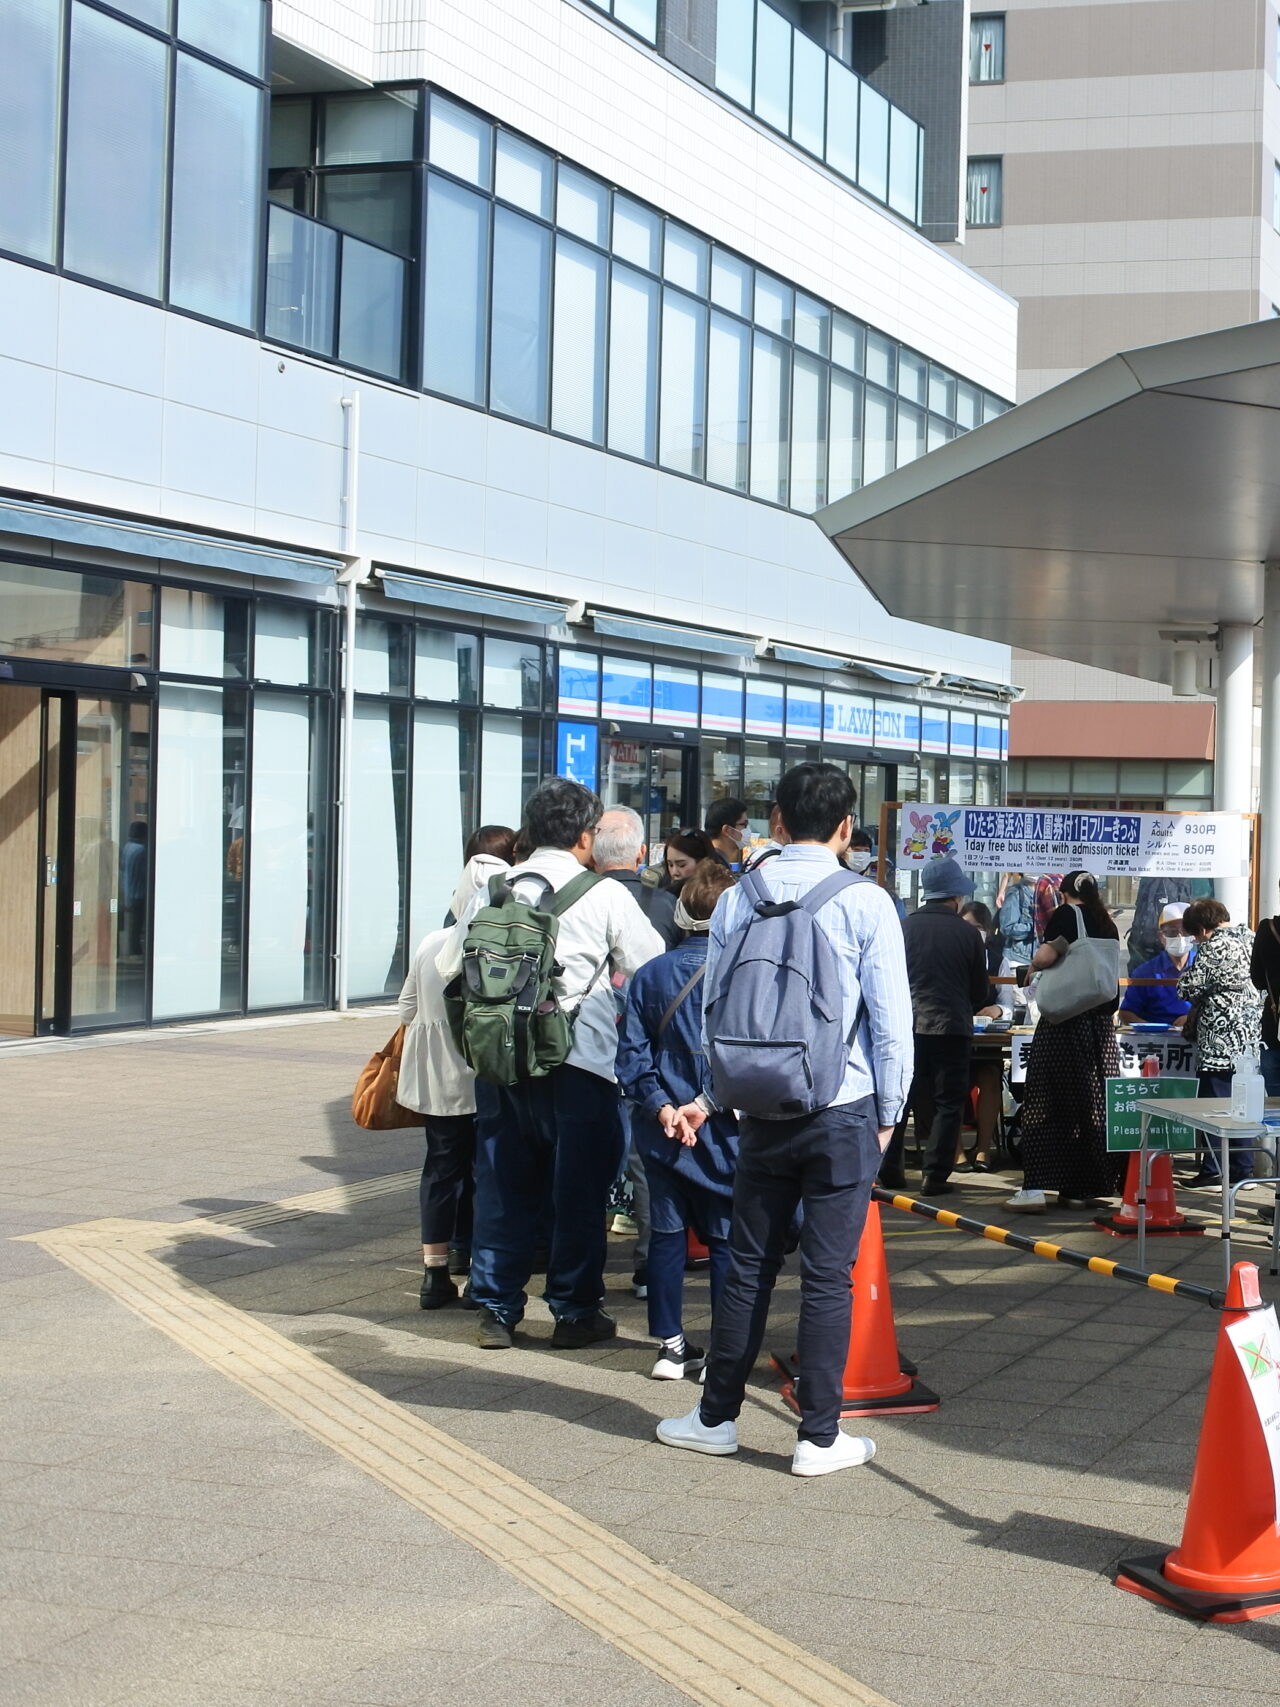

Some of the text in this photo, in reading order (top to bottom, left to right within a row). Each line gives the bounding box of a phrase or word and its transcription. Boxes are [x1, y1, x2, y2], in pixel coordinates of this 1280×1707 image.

[838, 704, 902, 738] LAWSON
[617, 743, 640, 762] ATM
[1150, 829, 1173, 837] Adults
[1185, 824, 1216, 835] 930円
[965, 839, 1139, 856] 1day free bus ticket with admission ticket
[1146, 841, 1179, 849] シルバー
[1184, 844, 1215, 855] 850円
[1114, 1083, 1160, 1095] こちらで
[1150, 1126, 1169, 1135] wait
